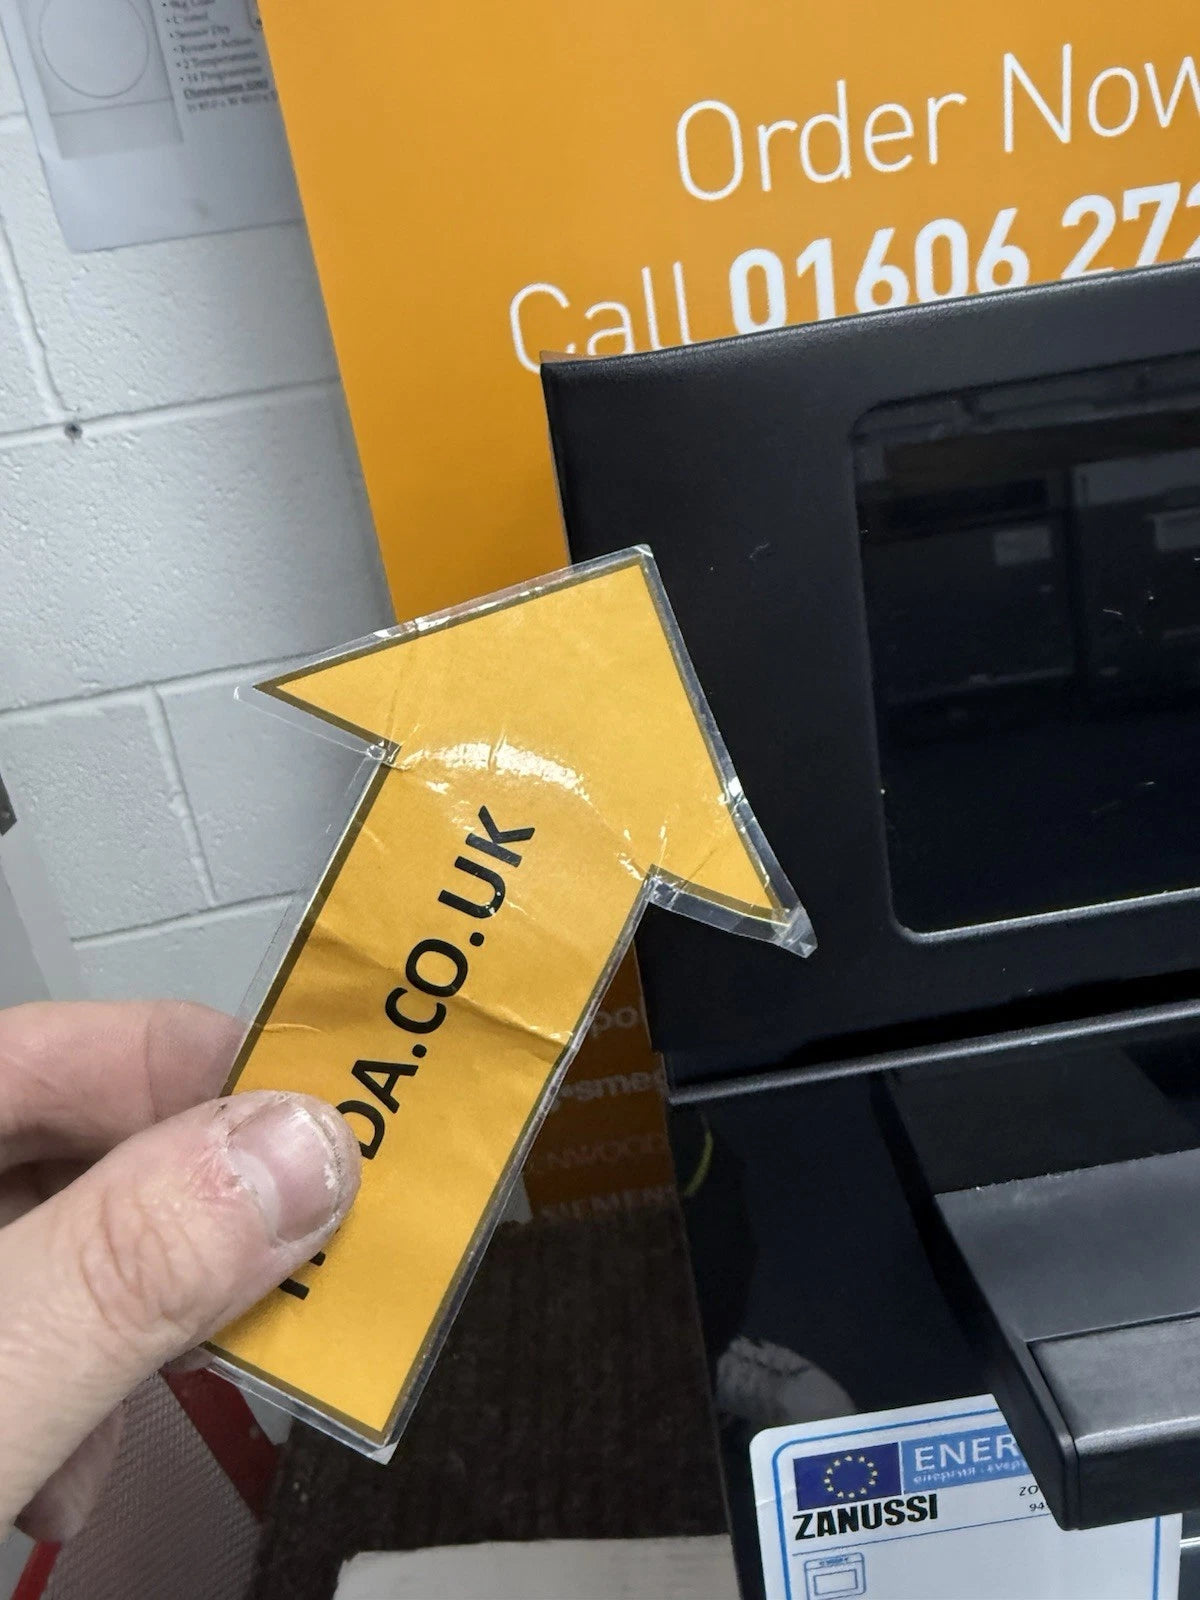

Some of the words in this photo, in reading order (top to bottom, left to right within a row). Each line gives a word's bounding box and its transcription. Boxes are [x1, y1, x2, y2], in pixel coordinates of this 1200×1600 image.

[676, 79, 967, 202] Order
[508, 261, 693, 375] Call
[728, 207, 1031, 335] 01606
[1060, 181, 1200, 280] 27
[914, 1434, 1020, 1472] ENER
[1019, 1485, 1039, 1497] ZO
[792, 1493, 938, 1541] ZANUSSI
